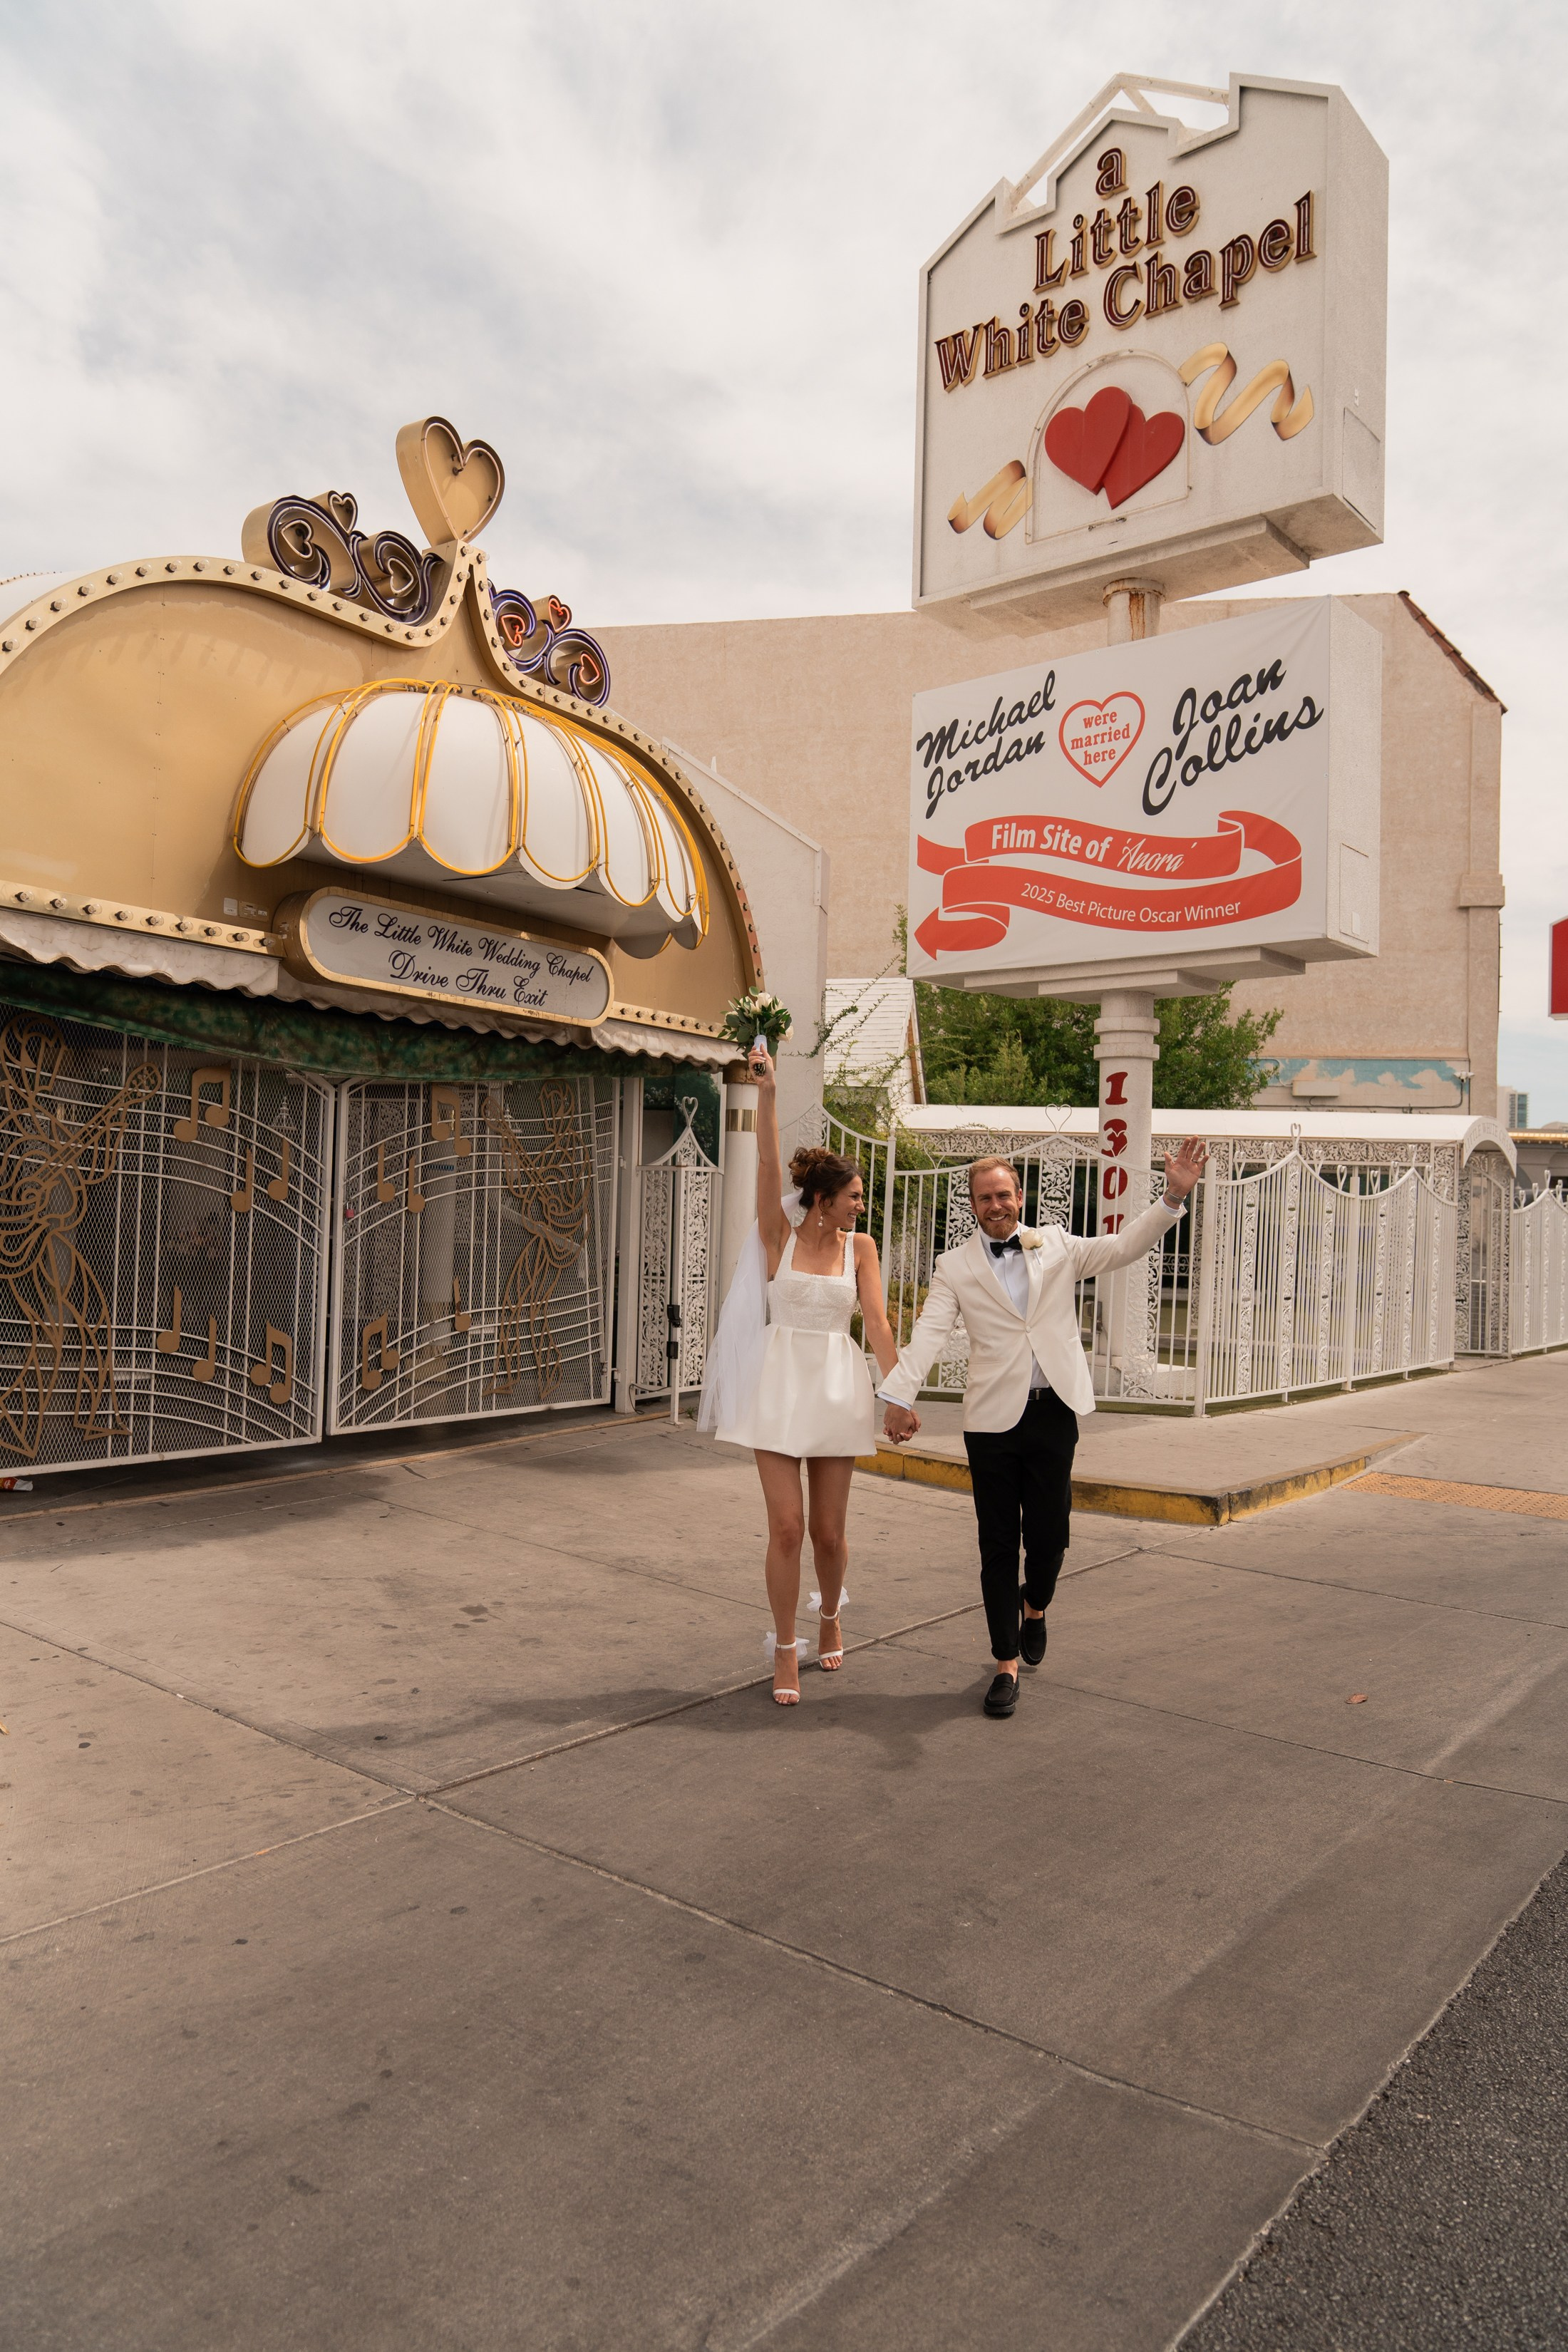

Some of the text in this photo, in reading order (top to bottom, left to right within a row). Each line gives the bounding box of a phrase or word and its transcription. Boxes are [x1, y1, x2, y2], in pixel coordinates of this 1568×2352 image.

[1095, 148, 1128, 200] a
[1033, 180, 1200, 295] Little
[934, 190, 1317, 393] White Chapel
[917, 670, 1056, 768] Michael
[1071, 724, 1130, 749] married
[1083, 711, 1118, 729] were
[1172, 659, 1287, 759] Joan
[925, 731, 1046, 819] Jordan
[1083, 746, 1117, 766] here
[1142, 696, 1324, 815] Collins
[991, 822, 1036, 850] Film
[1040, 824, 1082, 855] Site
[1085, 836, 1113, 862] of
[1021, 882, 1241, 923] 2025 Best Picture Oscar Winner
[329, 906, 594, 986] The Little White Wedding Chapel
[388, 949, 549, 1006] Drive Thru Exit
[1482, 1123, 1498, 1138] WHITE
